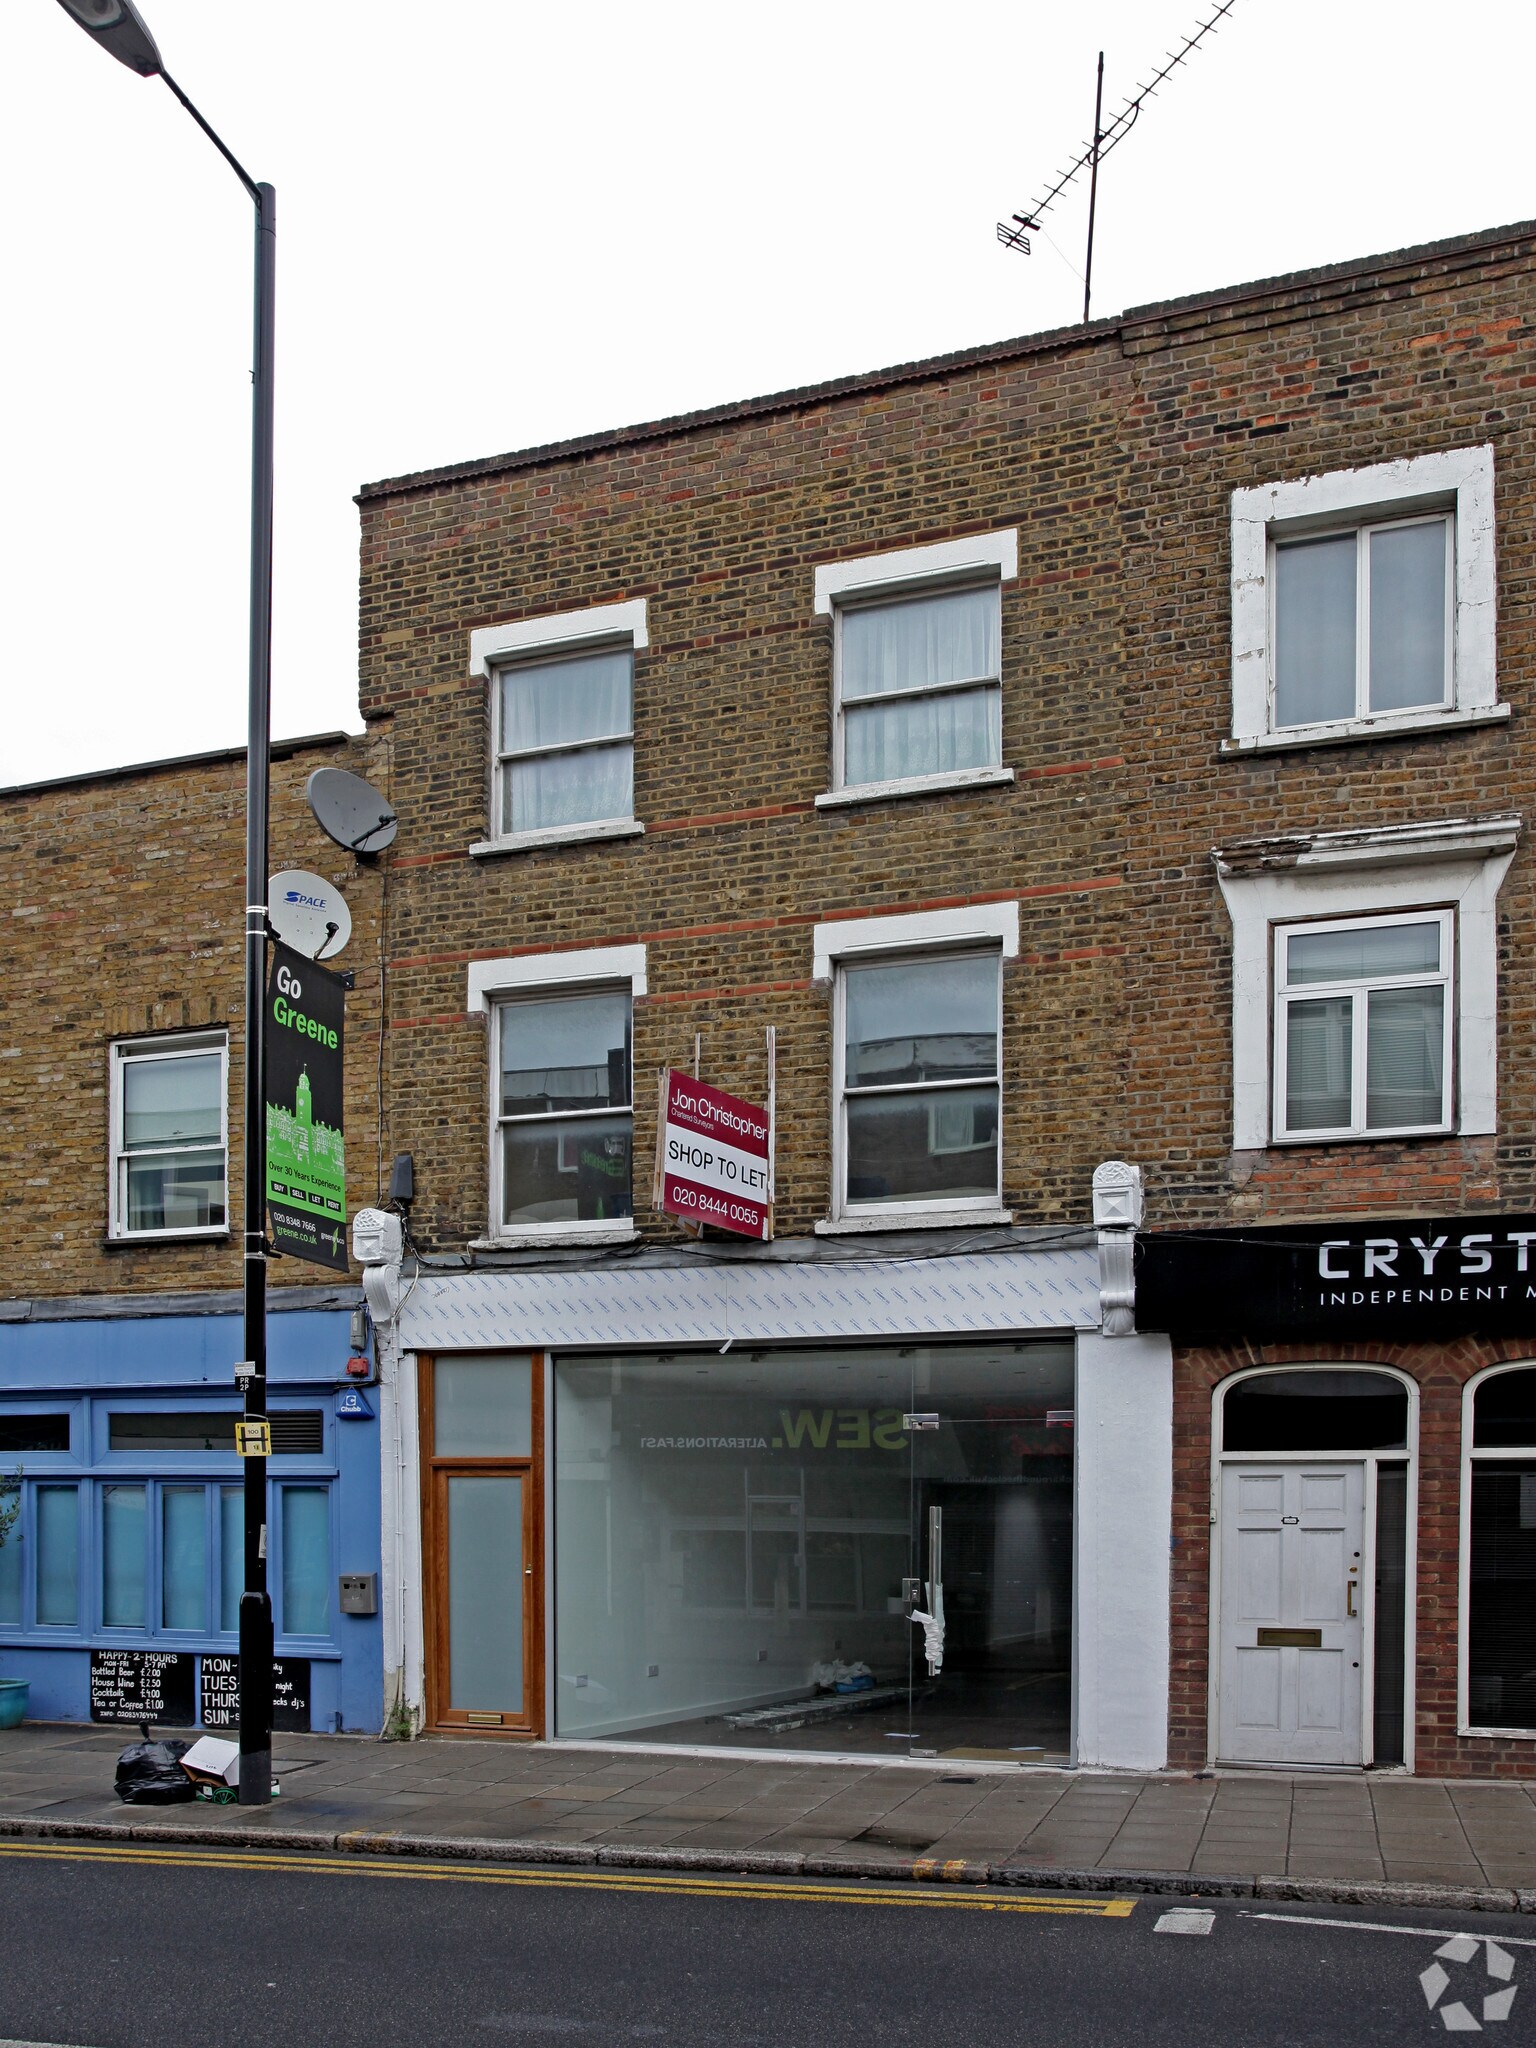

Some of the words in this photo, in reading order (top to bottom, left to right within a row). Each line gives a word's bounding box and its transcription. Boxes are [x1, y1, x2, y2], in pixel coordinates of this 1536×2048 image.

[284, 892, 327, 908] SPACE
[277, 966, 302, 999] Go
[274, 996, 337, 1049] Greene
[671, 1107, 693, 1121] Chartered
[693, 1116, 714, 1130] Surveyors
[672, 1088, 696, 1112] Jon
[698, 1098, 767, 1140] Christopher
[669, 1140, 713, 1169] SHOP
[718, 1156, 736, 1179] TO
[741, 1166, 766, 1189] LET
[268, 1161, 283, 1172] Over
[284, 1166, 292, 1176] 30
[294, 1169, 310, 1182] Years
[311, 1175, 341, 1192] Experience
[274, 1184, 284, 1192] BUY
[292, 1189, 304, 1198] SELL
[327, 1200, 339, 1210] RENT
[673, 1186, 696, 1206] 020
[699, 1194, 728, 1216] 8444
[730, 1204, 758, 1225] 0055
[274, 1212, 285, 1223] 020
[286, 1215, 300, 1227] 8348
[302, 1221, 316, 1232] 7666
[276, 1226, 317, 1245] greene.co.uk
[1318, 1232, 1536, 1279] CRYST
[1320, 1286, 1507, 1305] INDEPENDENT
[92, 1667, 115, 1675] Bottled
[119, 1668, 134, 1676] Beer
[140, 1668, 160, 1677] £2.00
[92, 1677, 115, 1687] House
[118, 1678, 134, 1687] Wine
[140, 1678, 160, 1687] £2.50
[92, 1688, 124, 1696] Cocktails
[140, 1689, 160, 1698] £4.00
[276, 1682, 293, 1693] night
[92, 1698, 105, 1706] Tea
[120, 1698, 143, 1710] Coffee
[145, 1699, 164, 1709] £1.00
[291, 1698, 305, 1710] dj's
